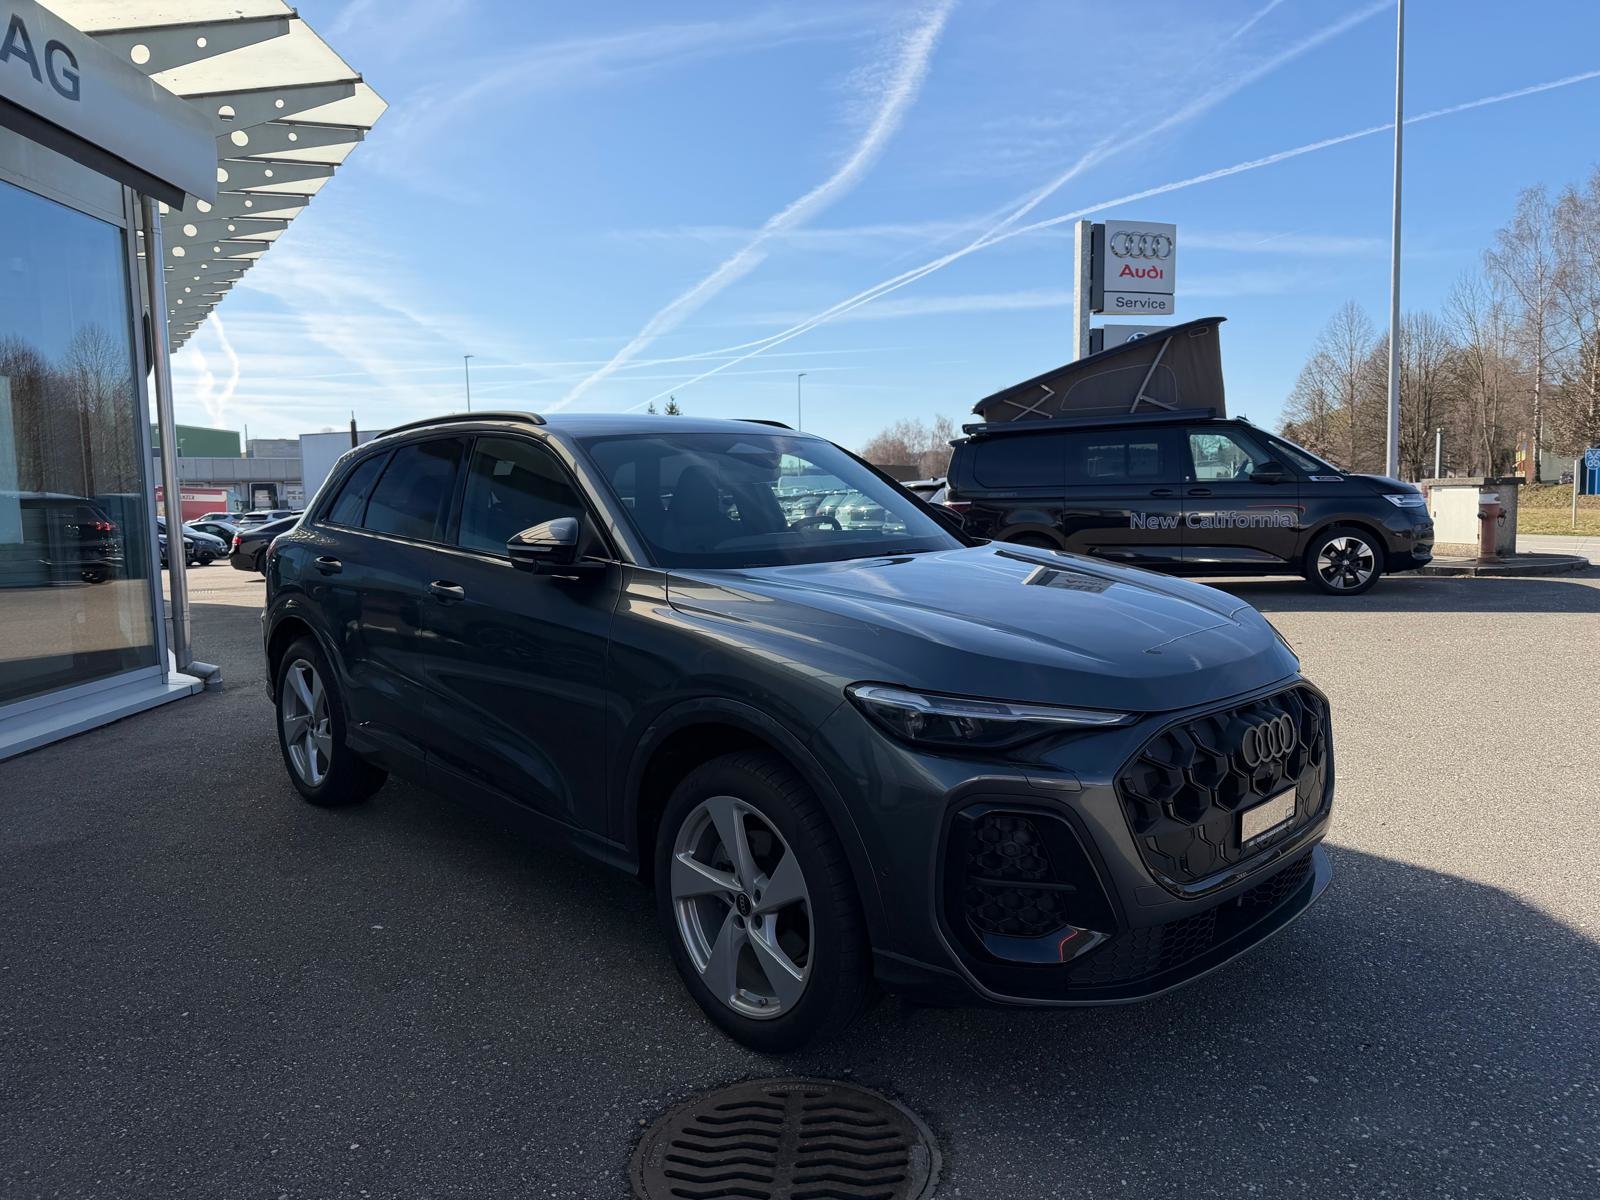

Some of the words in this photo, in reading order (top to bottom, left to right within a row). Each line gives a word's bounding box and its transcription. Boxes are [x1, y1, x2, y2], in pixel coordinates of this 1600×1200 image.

[0, 13, 80, 102] AG
[1119, 264, 1163, 280] Audi
[1115, 296, 1166, 310] Service
[1130, 512, 1179, 529] New
[1186, 509, 1294, 529] California
